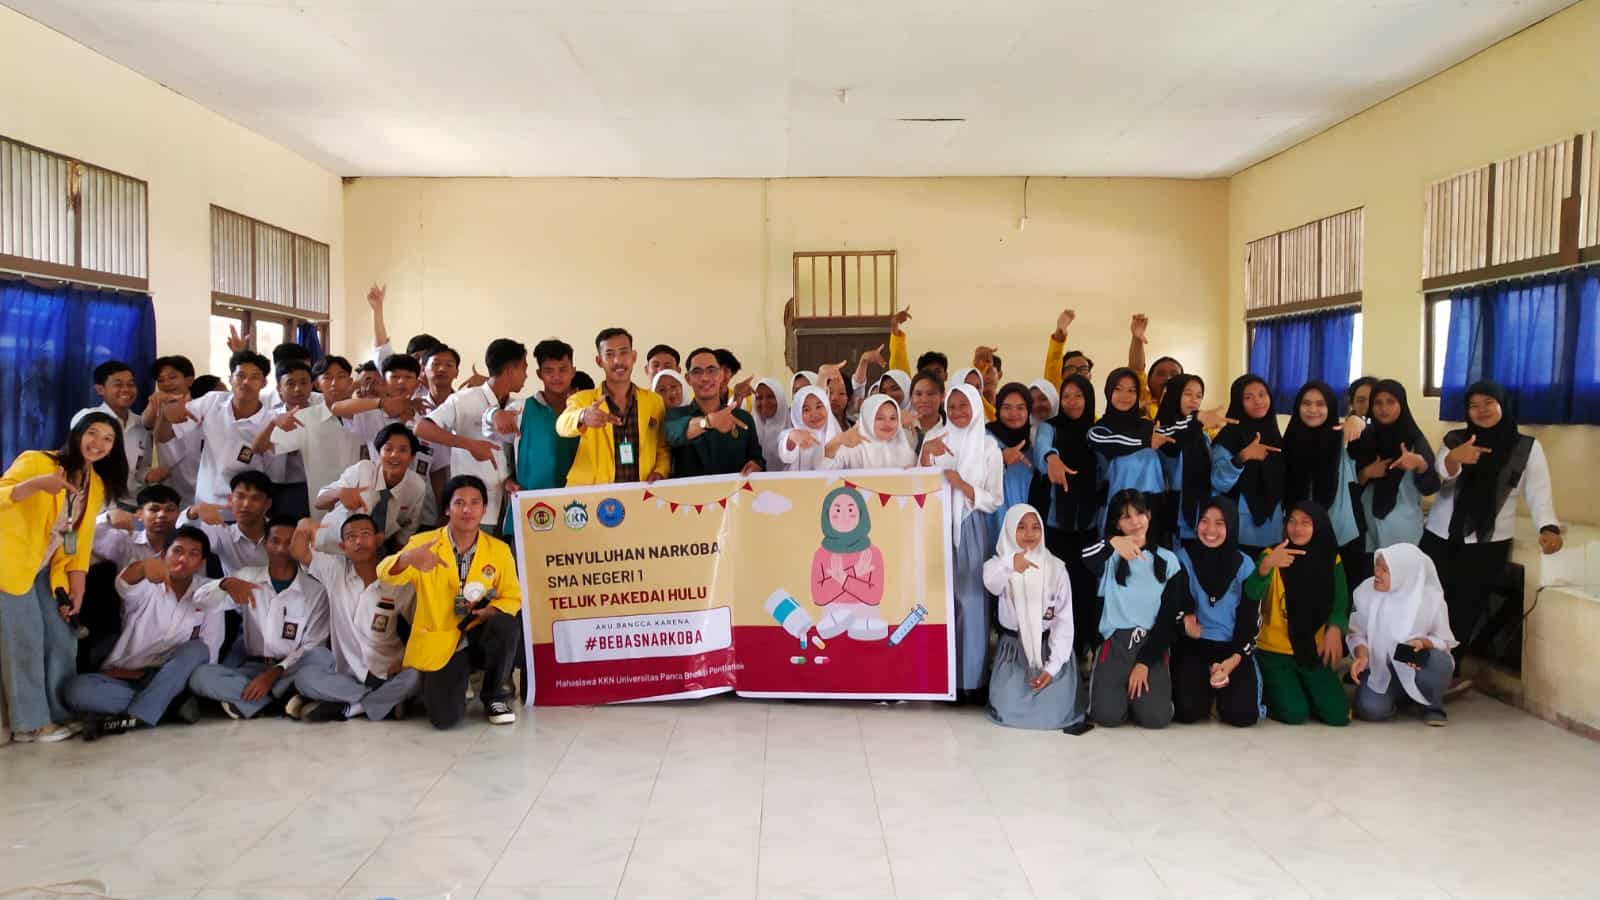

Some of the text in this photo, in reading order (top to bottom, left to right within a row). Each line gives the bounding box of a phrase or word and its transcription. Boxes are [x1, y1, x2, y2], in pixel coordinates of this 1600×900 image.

[545, 542, 720, 567] PENYULUHAN NARKOBA
[547, 569, 644, 588] SMA NEGERI 1
[549, 586, 707, 610] TELUK PAKEDAI HULU
[595, 622, 613, 630] AKU
[655, 617, 689, 626] KARENA
[585, 629, 703, 651] #BEBASNARKOBA
[598, 675, 615, 685] KKN
[616, 673, 659, 684] Universitas
